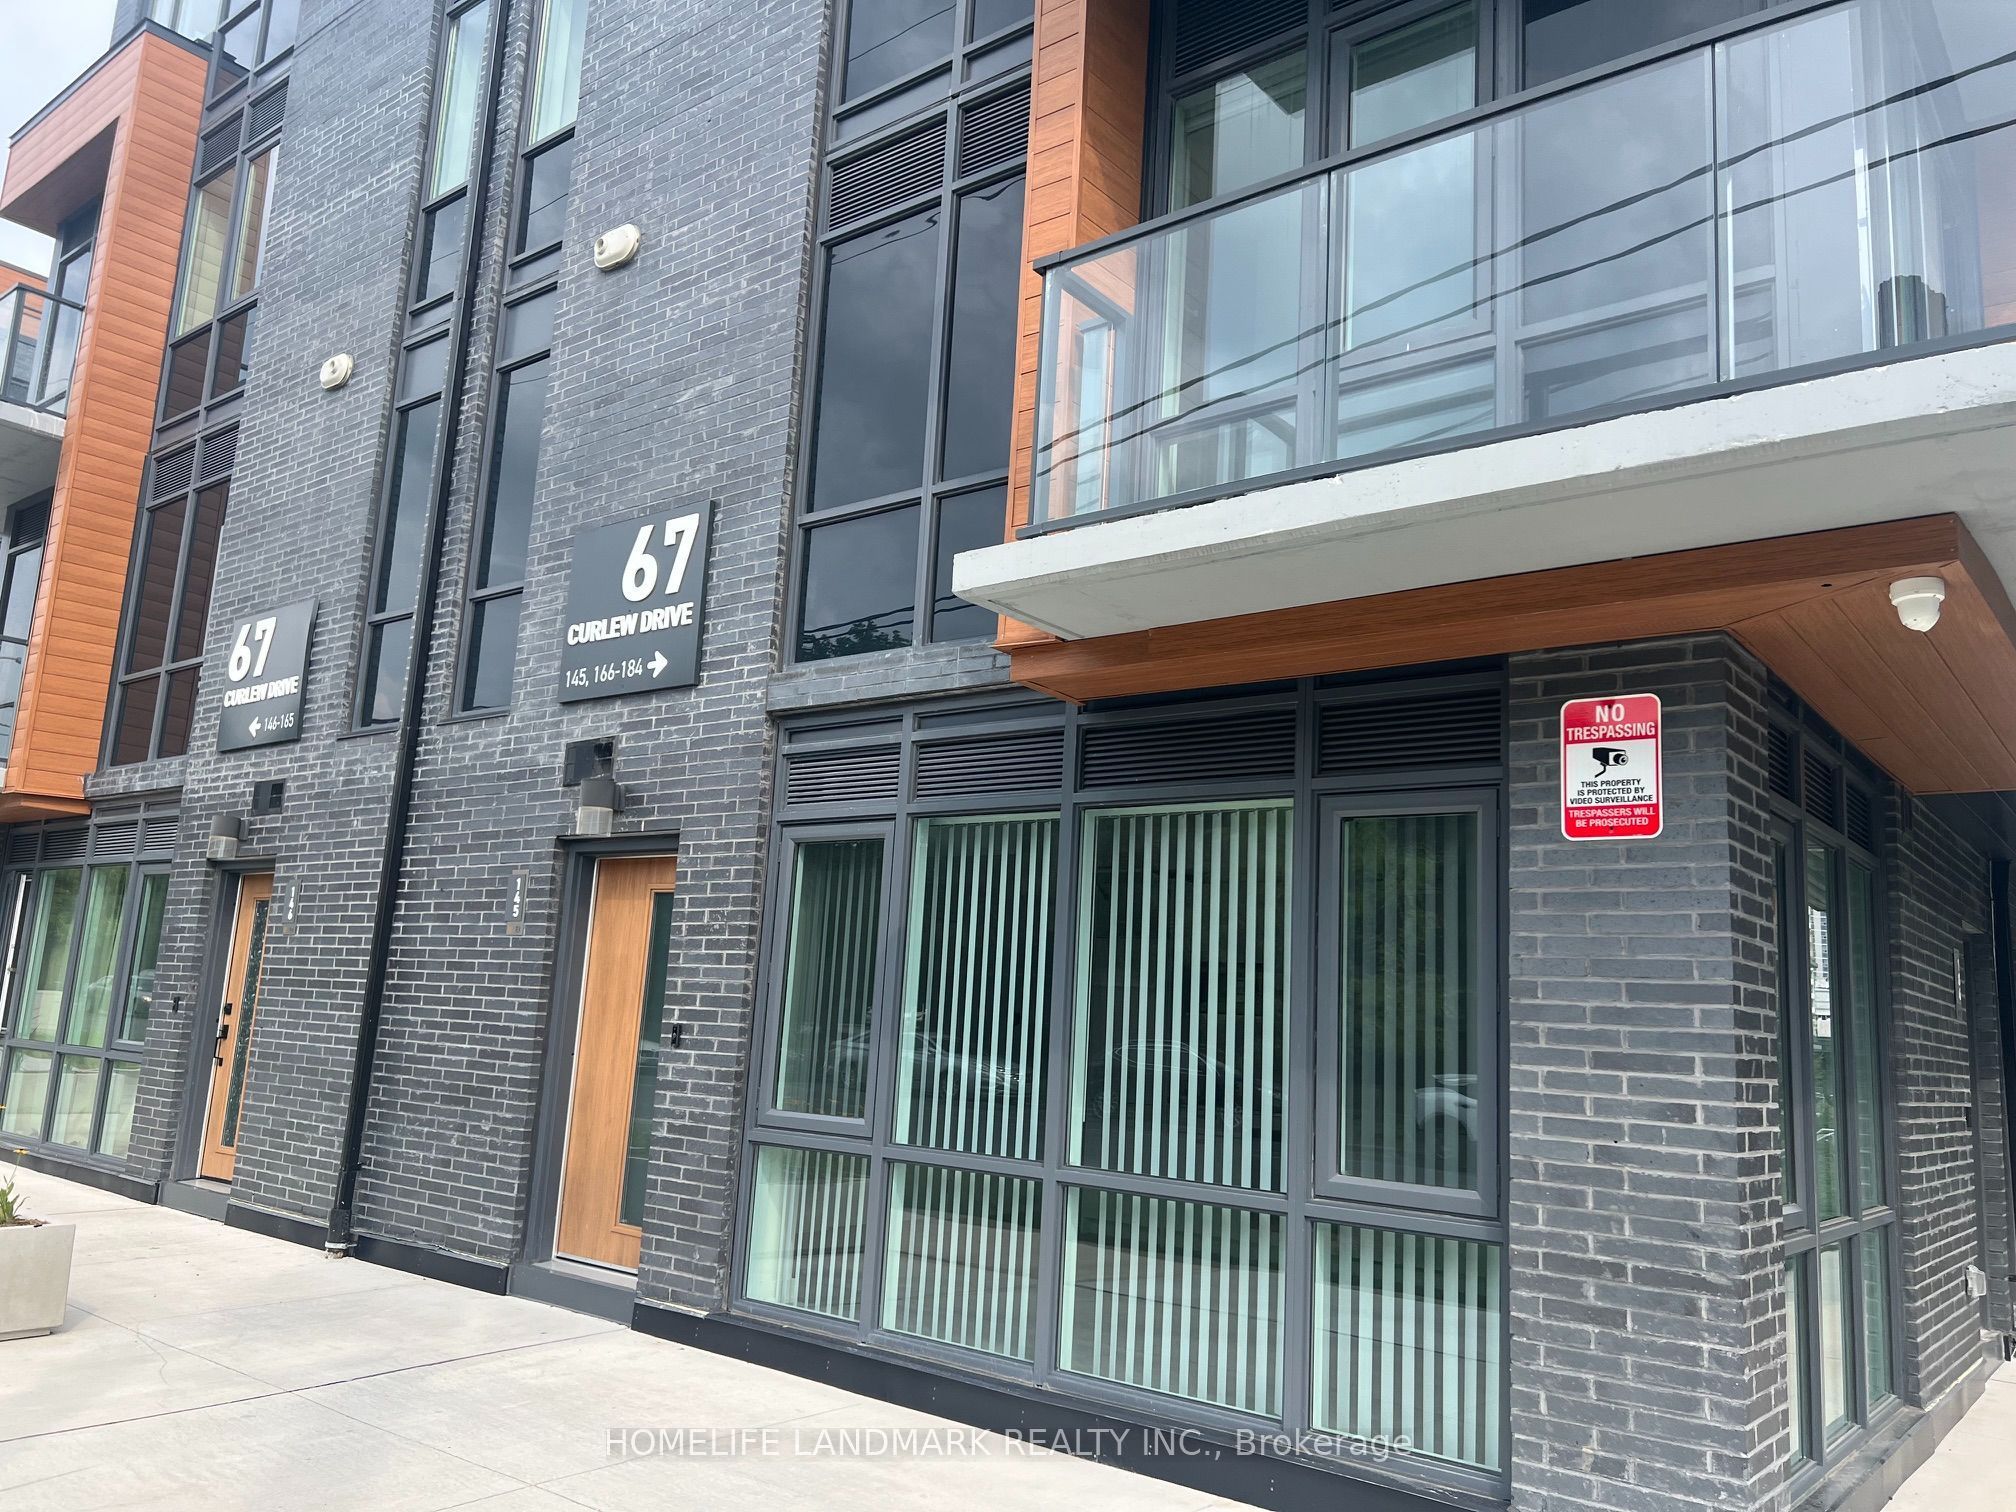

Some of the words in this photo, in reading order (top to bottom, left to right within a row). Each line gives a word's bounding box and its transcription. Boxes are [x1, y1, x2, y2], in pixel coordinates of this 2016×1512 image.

[621, 513, 700, 602] 67
[567, 612, 639, 646] CURLEW
[639, 602, 694, 633] DRIVE
[228, 616, 277, 682] 67
[565, 668, 589, 687] 145,
[594, 658, 643, 683] 166-184
[223, 683, 269, 708] CURLEW
[267, 675, 300, 699] DRIVE
[264, 712, 295, 732] 146-165
[1595, 703, 1625, 723] NO
[1566, 721, 1656, 741] TRESPASSING
[1581, 780, 1598, 788] THIS
[1600, 778, 1642, 788] PROPERTY
[1587, 787, 1632, 796] PROTECTED
[1634, 786, 1645, 794] BY
[1569, 797, 1593, 805] VIDEO
[1595, 794, 1653, 804] SURVEILLANCE
[1568, 807, 1632, 818] TRESPASSERS
[1633, 806, 1656, 815] WILL
[1575, 819, 1587, 828] BE
[1589, 817, 1649, 827] PROSECUTED
[512, 877, 521, 917] 145
